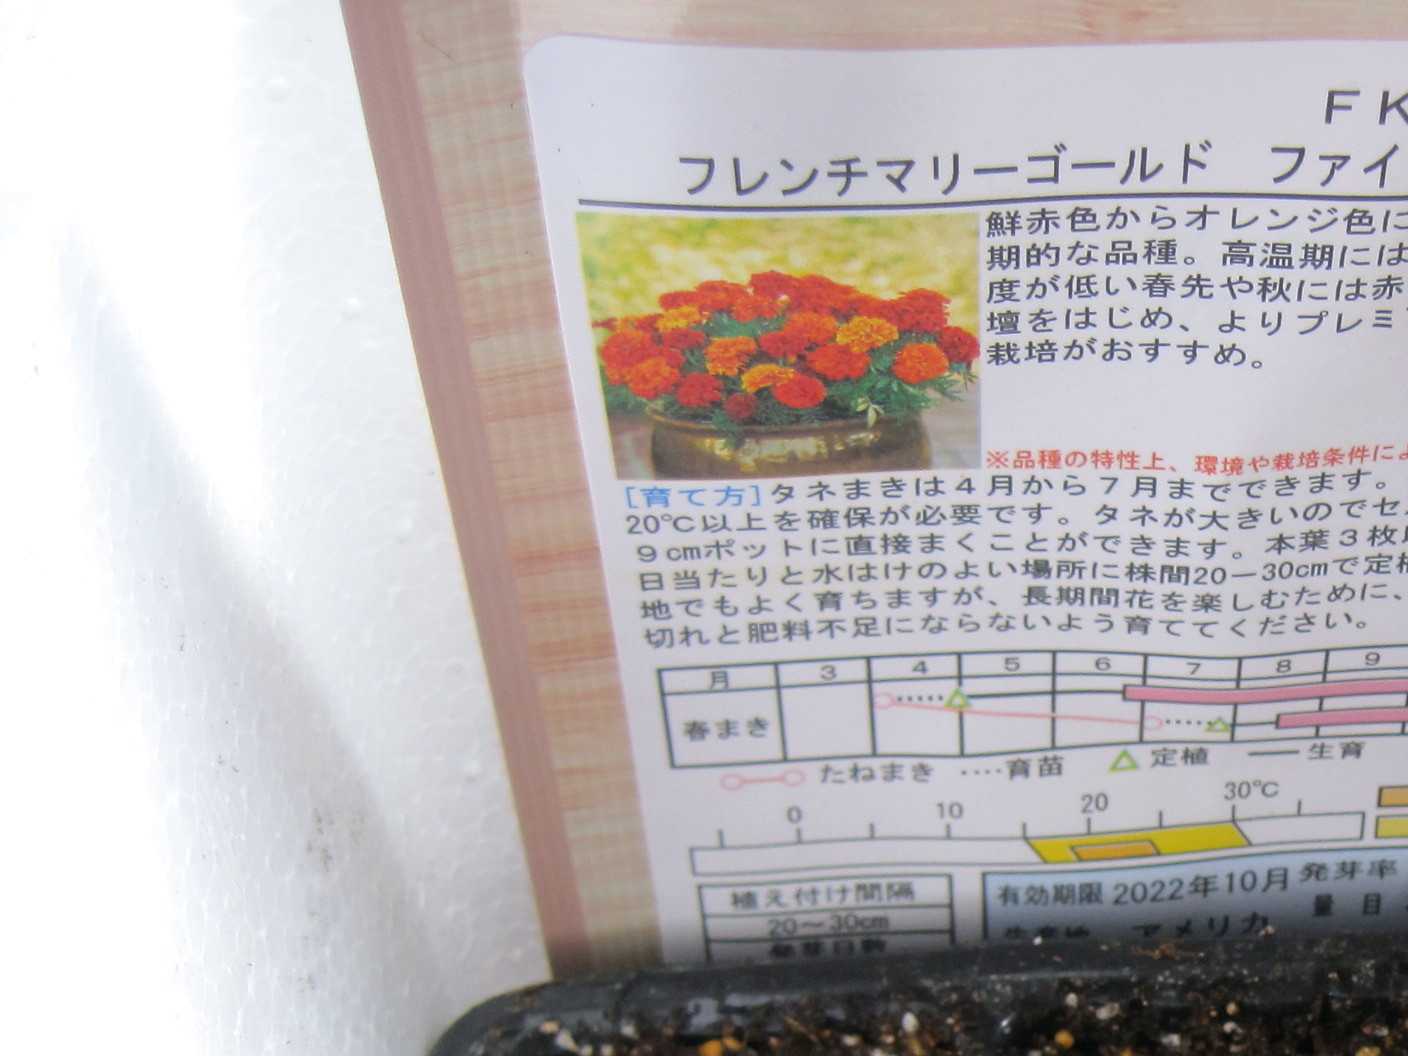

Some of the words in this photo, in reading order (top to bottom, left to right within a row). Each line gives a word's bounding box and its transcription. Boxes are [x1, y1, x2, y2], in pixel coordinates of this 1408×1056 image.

[679, 138, 1213, 197] フレンチマリーゴールド
[986, 338, 1265, 370] 栽培がおすすめ。
[707, 669, 731, 690] 月
[819, 664, 837, 681] 3
[911, 659, 929, 675] 4
[1004, 656, 1021, 672] 5
[1094, 656, 1111, 671] 6
[1184, 661, 1203, 677] 7
[1275, 658, 1293, 674] 8
[1363, 651, 1381, 667] 9
[683, 715, 770, 742] 春まき
[819, 762, 935, 785] たねまき
[1006, 755, 1065, 781] 育苗
[1150, 745, 1210, 769] 定植
[1307, 740, 1366, 761] 生育
[786, 805, 803, 824] 0
[937, 801, 964, 820] 10
[1081, 793, 1109, 815] 20
[998, 881, 1104, 907] 有効期限
[1112, 866, 1289, 907] 2022年10月
[1299, 858, 1398, 883] 発芽率
